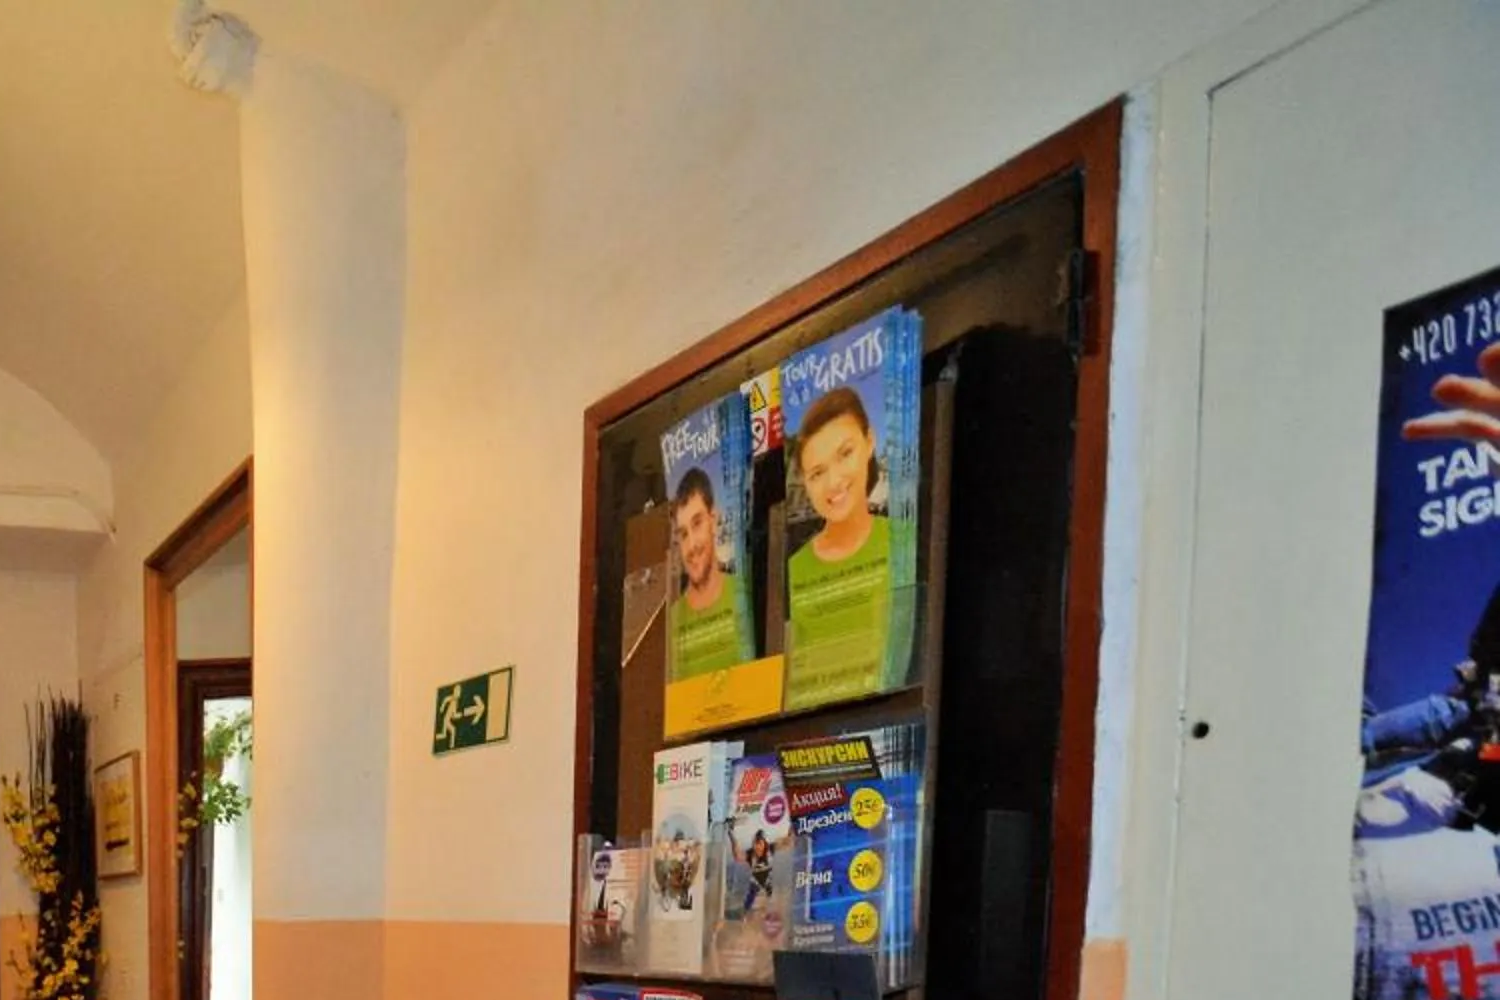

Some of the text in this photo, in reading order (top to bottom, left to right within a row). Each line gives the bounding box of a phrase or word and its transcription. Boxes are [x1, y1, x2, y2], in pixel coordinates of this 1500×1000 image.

[813, 327, 882, 392] GRATIS
[1399, 314, 1457, 364] +420
[660, 420, 692, 476] FREE
[690, 423, 721, 459] TOUR
[1418, 481, 1500, 537] SIG
